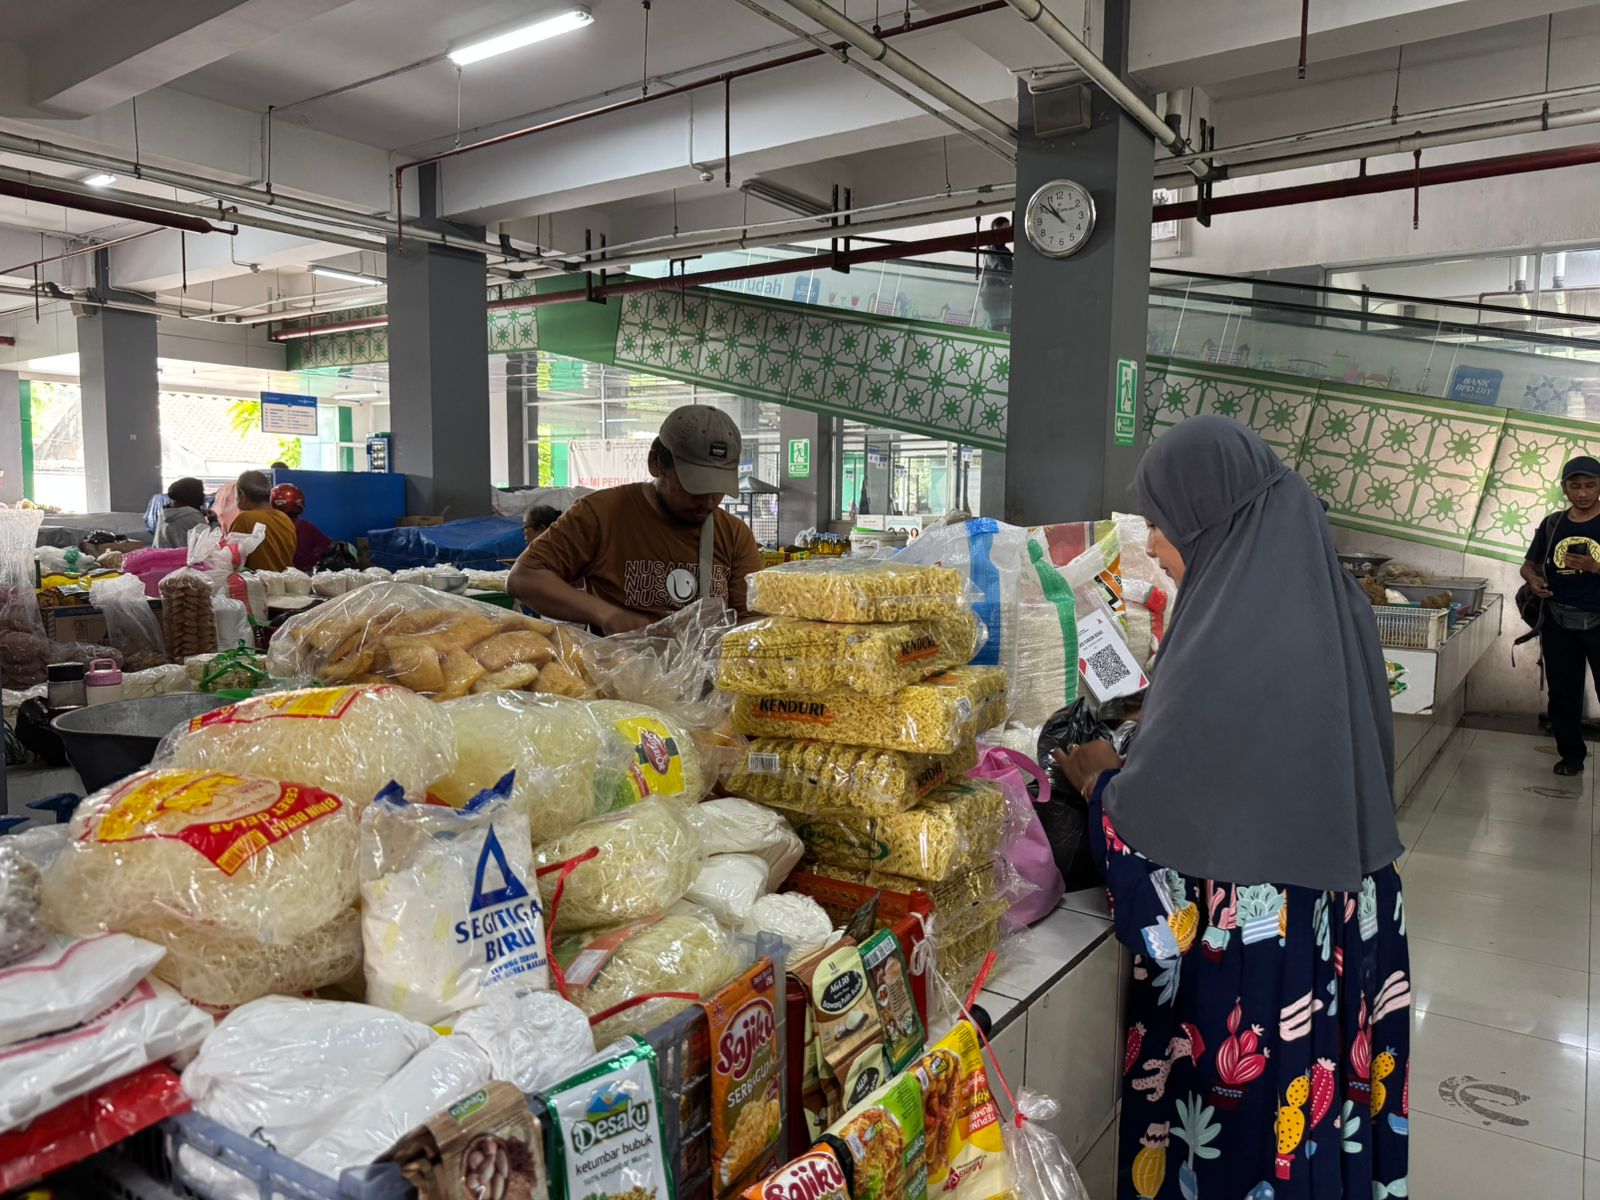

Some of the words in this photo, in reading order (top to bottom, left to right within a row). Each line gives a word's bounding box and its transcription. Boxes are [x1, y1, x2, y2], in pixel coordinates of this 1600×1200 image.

[1055, 190, 1064, 200] 12
[1074, 199, 1081, 208] 2
[1037, 218, 1042, 226] 9
[1078, 211, 1084, 220] 3
[1040, 229, 1046, 237] 8
[1075, 223, 1082, 231] 4
[1048, 236, 1054, 244] 7
[1059, 238, 1065, 246] 6
[1069, 233, 1075, 241] 5
[1463, 377, 1490, 387] BANK
[758, 698, 825, 716] KENDURI
[644, 729, 666, 770] SUPERIOR
[272, 786, 299, 815] CERET
[304, 797, 338, 818] BIHUN
[208, 812, 270, 833] GELAS
[271, 811, 309, 837] BERAS
[455, 901, 543, 943] SEGITIGA
[485, 926, 536, 963] BIRU
[490, 959, 519, 975] TEPUNG
[830, 975, 850, 993] AGLIO
[715, 1009, 776, 1080] Sajiku
[572, 1098, 648, 1154] Desaku
[575, 1148, 620, 1176] ketumbar
[622, 1134, 654, 1155] bubuk
[765, 1160, 846, 1200] Sajiku
